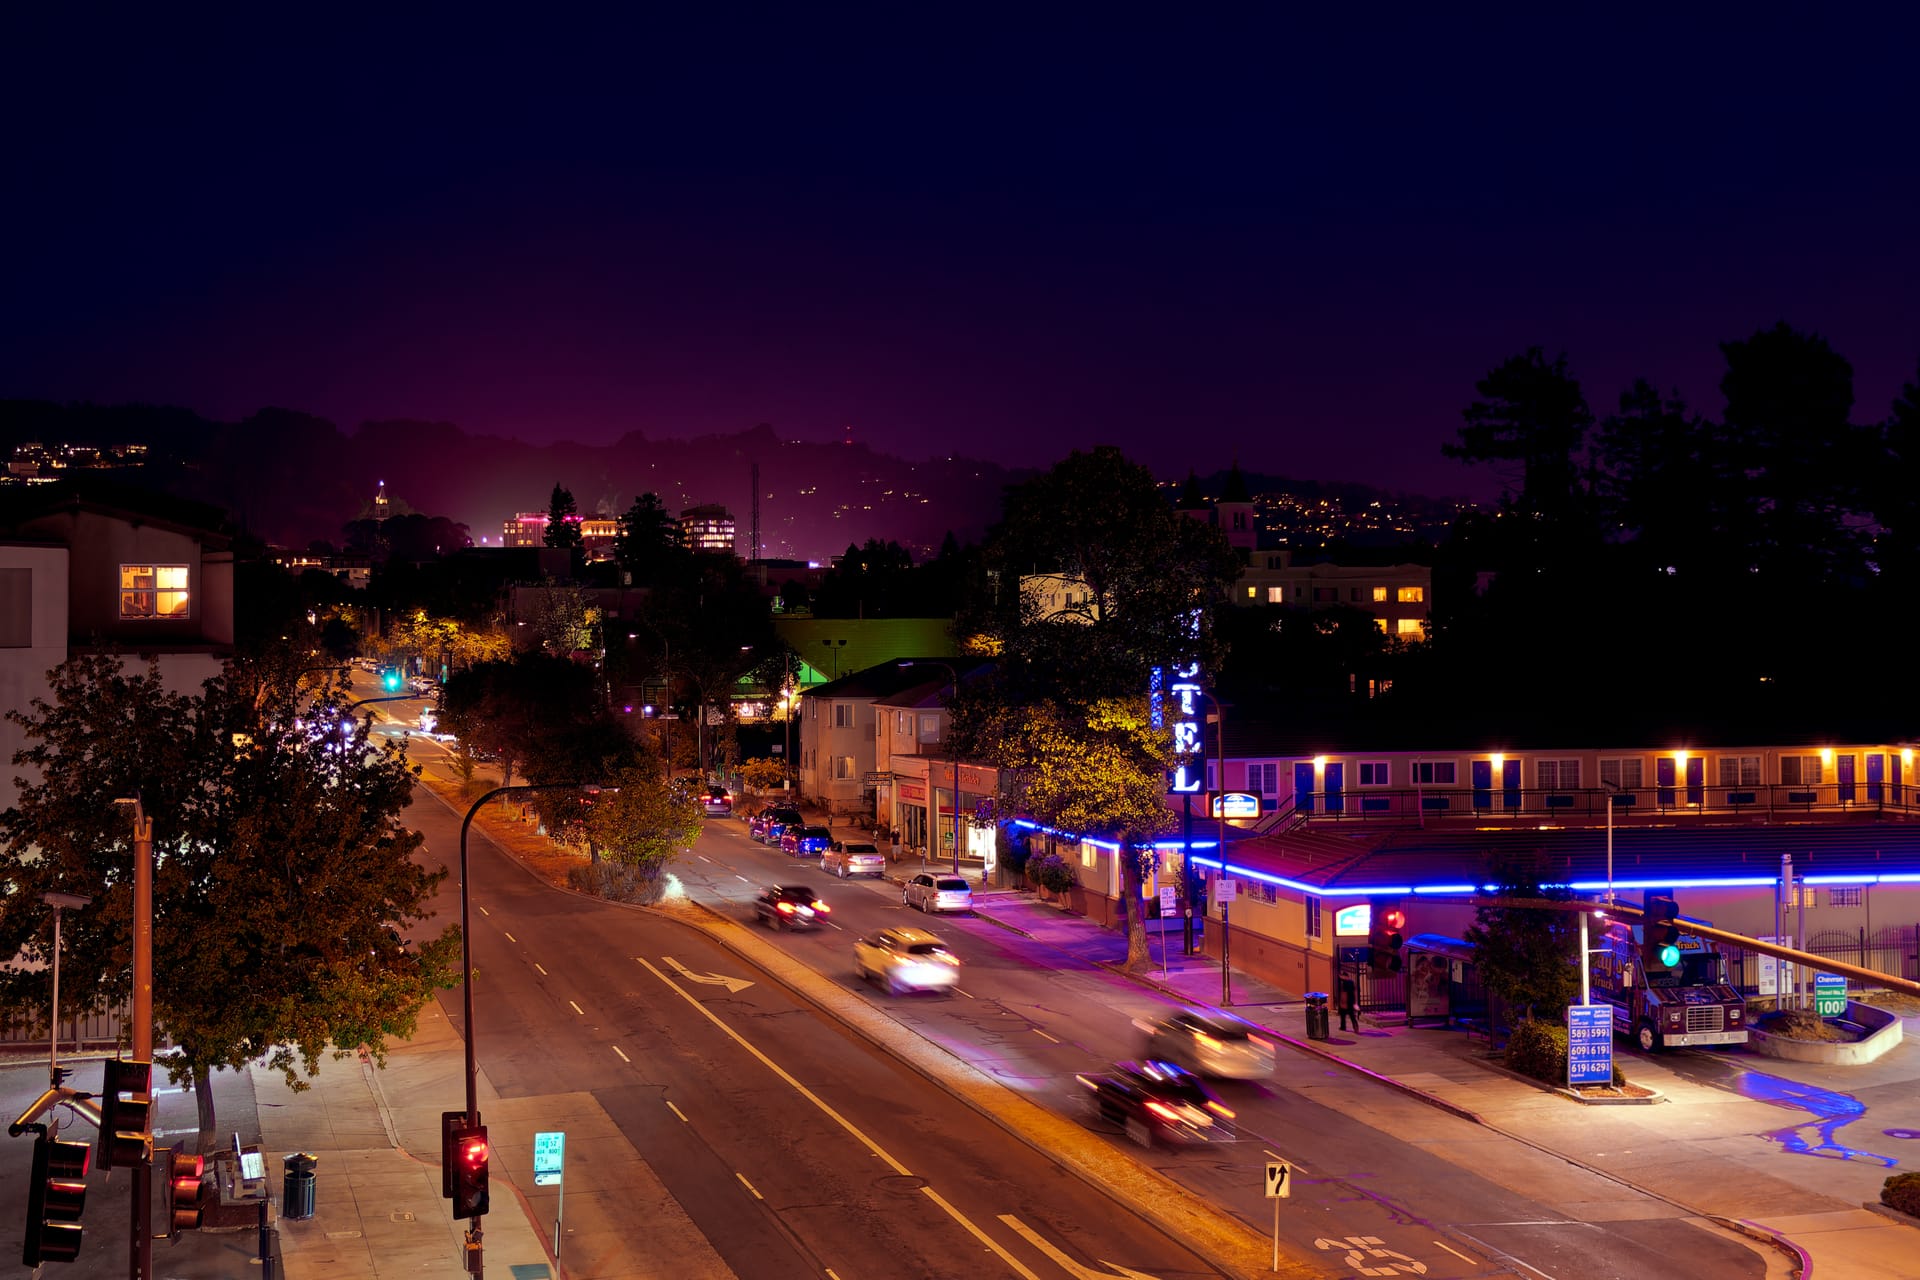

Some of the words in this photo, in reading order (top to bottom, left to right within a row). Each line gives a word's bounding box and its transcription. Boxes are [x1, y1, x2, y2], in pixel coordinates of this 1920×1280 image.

[1818, 1001, 1840, 1014] 100
[1571, 1029, 1587, 1038] 589
[1591, 1029, 1606, 1038] 599
[1571, 1046, 1587, 1055] 609
[1591, 1046, 1606, 1055] 619
[1571, 1063, 1586, 1073] 619
[1591, 1063, 1606, 1072] 629
[1314, 1236, 1428, 1277] 25
